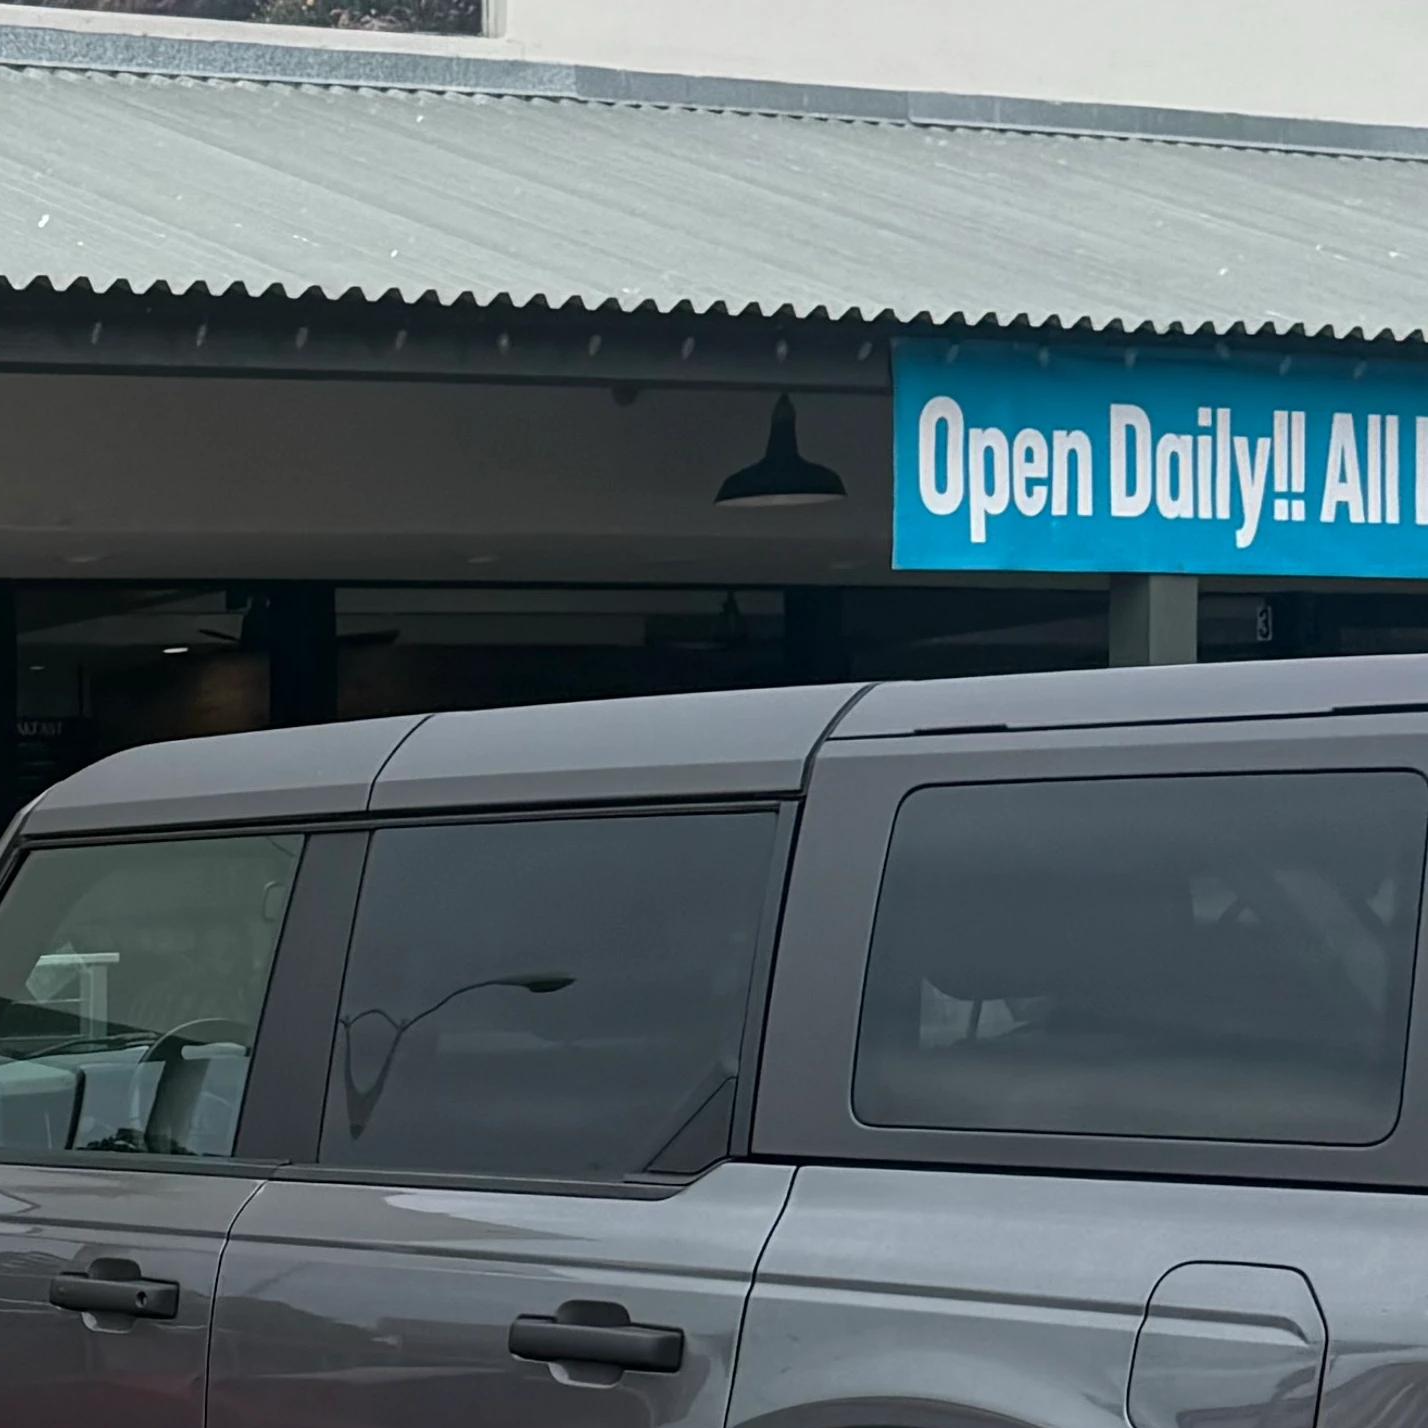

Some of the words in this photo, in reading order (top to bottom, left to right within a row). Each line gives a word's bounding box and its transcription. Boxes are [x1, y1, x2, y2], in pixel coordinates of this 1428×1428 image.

[919, 395, 1093, 543] Open
[1110, 403, 1306, 549] Daily!!
[1319, 413, 1400, 524] All
